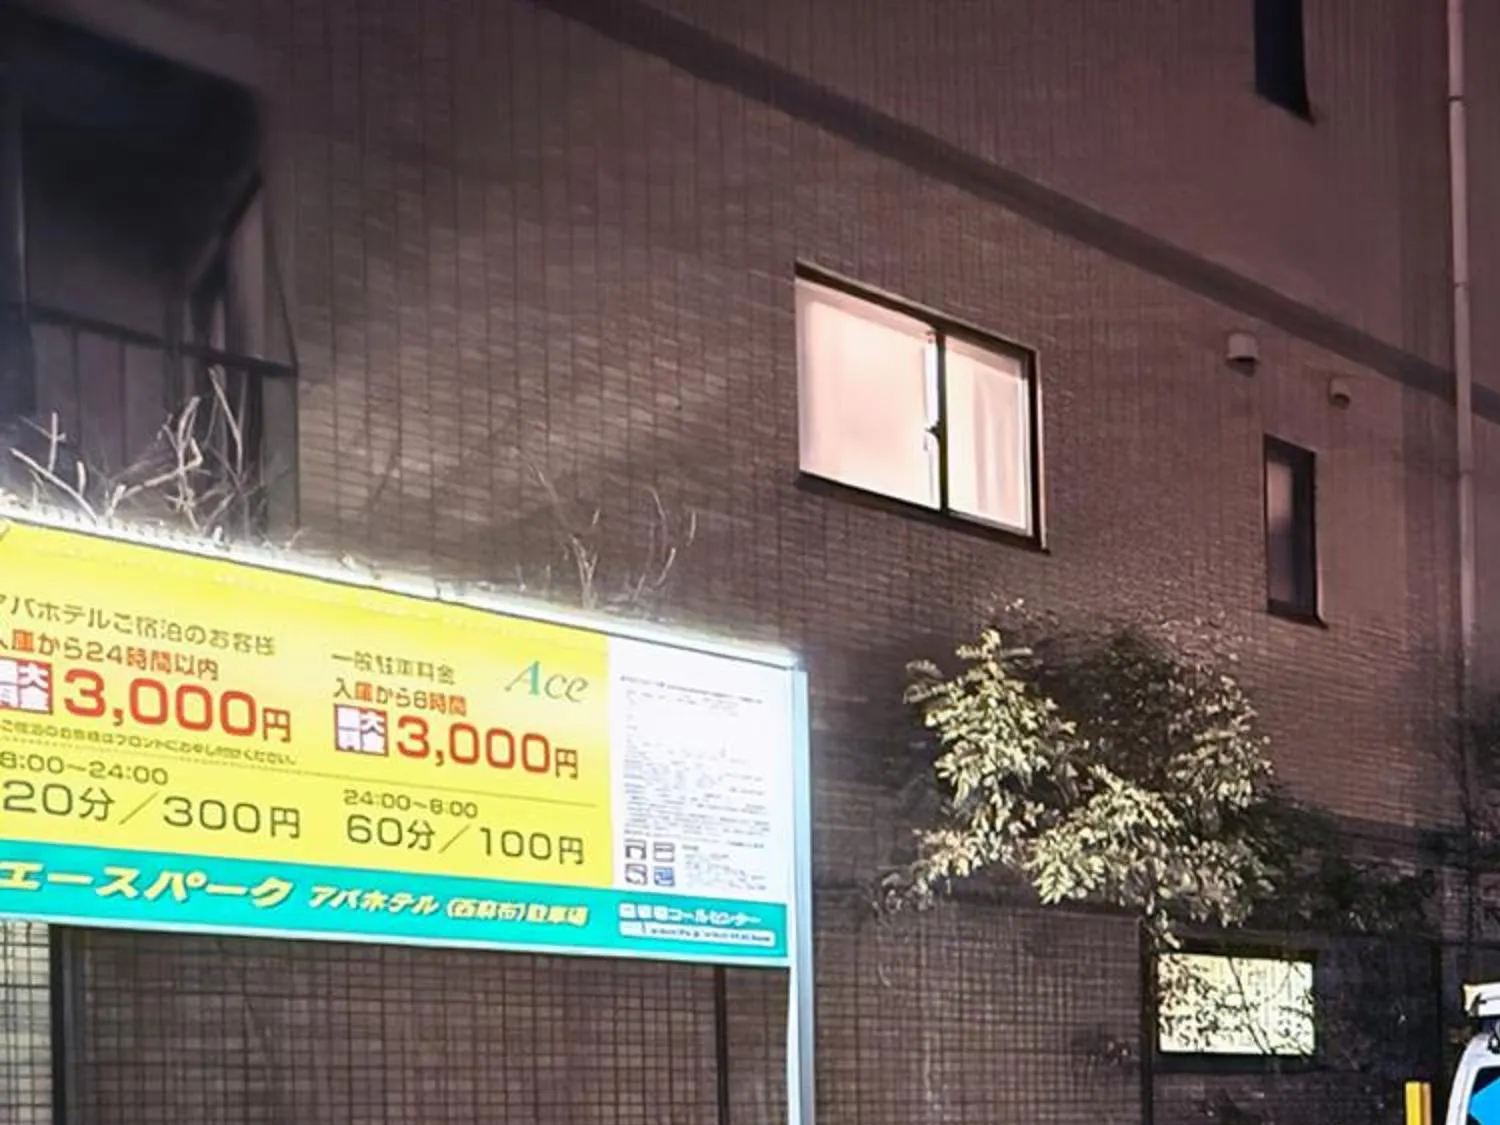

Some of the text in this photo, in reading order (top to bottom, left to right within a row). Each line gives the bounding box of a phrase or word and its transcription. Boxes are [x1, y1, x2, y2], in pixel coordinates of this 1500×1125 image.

[63, 667, 291, 743] 3,000円
[504, 660, 589, 702] Ace
[396, 715, 578, 779] 3,000円
[0, 859, 294, 909] エースパーク
